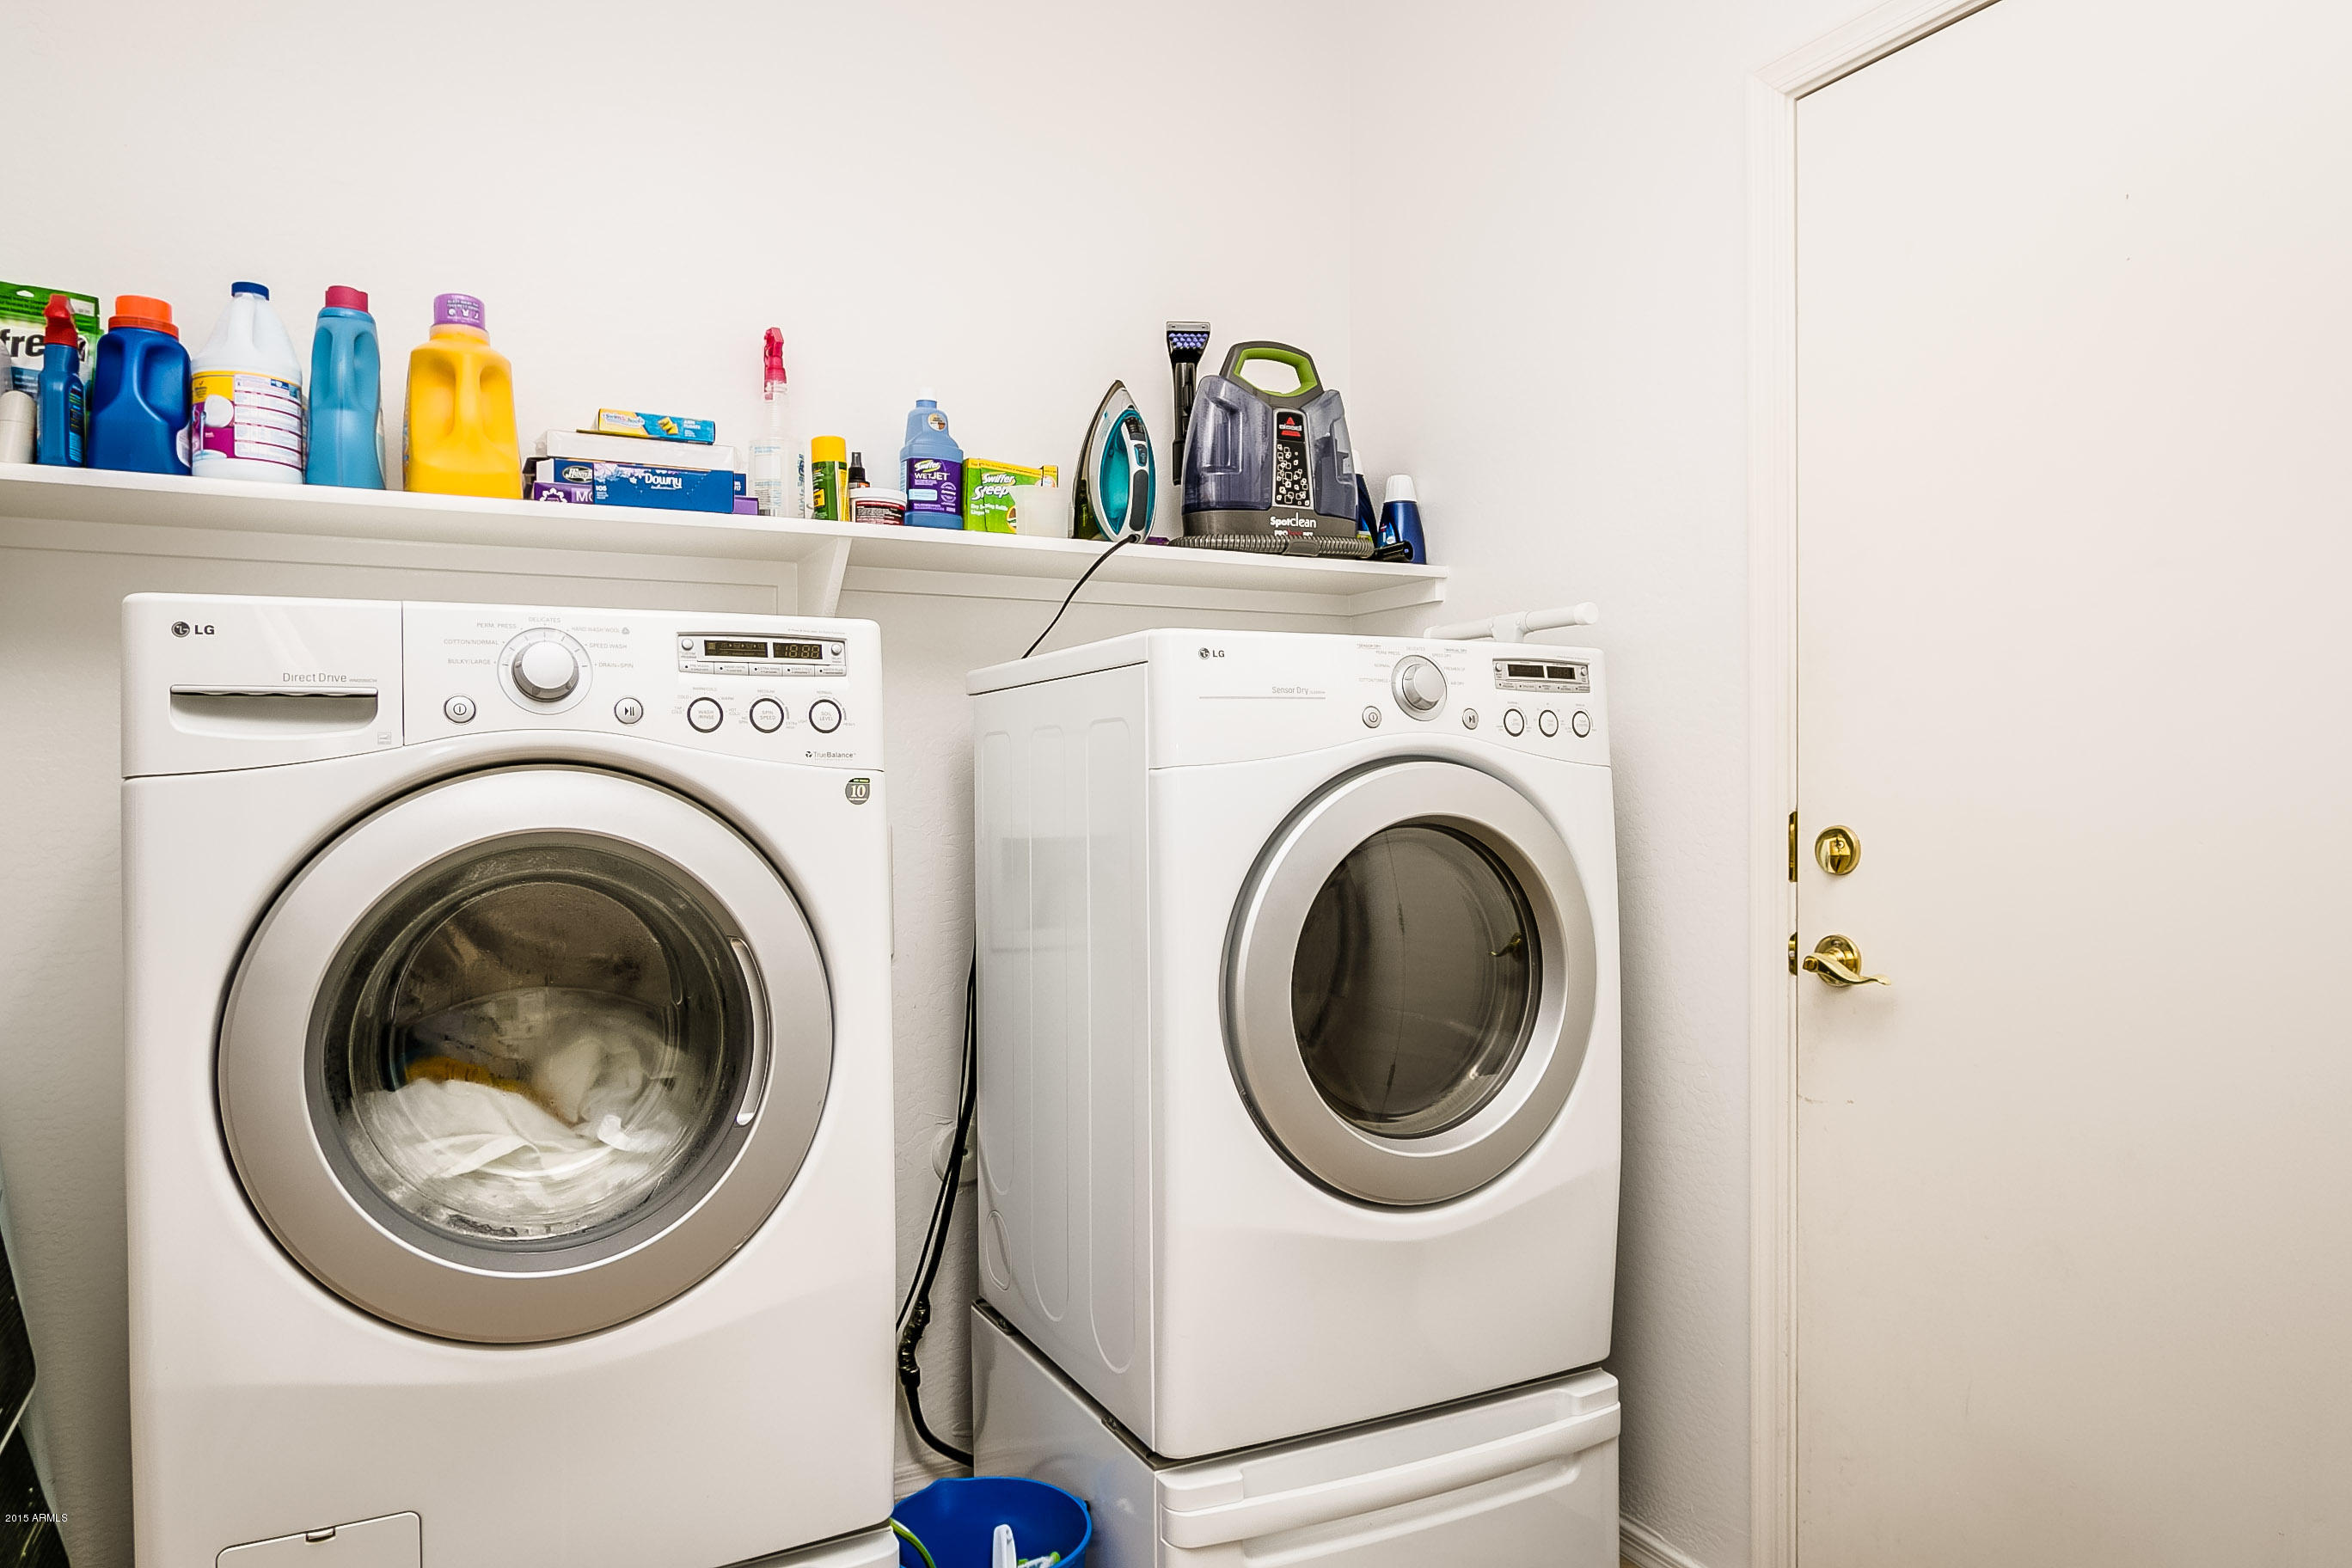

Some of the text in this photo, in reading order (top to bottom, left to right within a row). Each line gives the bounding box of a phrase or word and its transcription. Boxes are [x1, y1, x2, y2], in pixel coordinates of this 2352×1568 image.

[645, 473, 683, 489] Downy
[982, 473, 1015, 484] Swiffer
[971, 486, 1009, 500] Sweep
[194, 624, 215, 635] LG
[1212, 649, 1225, 658] LG
[283, 672, 316, 683] Direct
[318, 672, 347, 683] Drive
[1271, 686, 1295, 695] Sensor
[1296, 686, 1309, 695] Dry
[850, 784, 867, 798] 10
